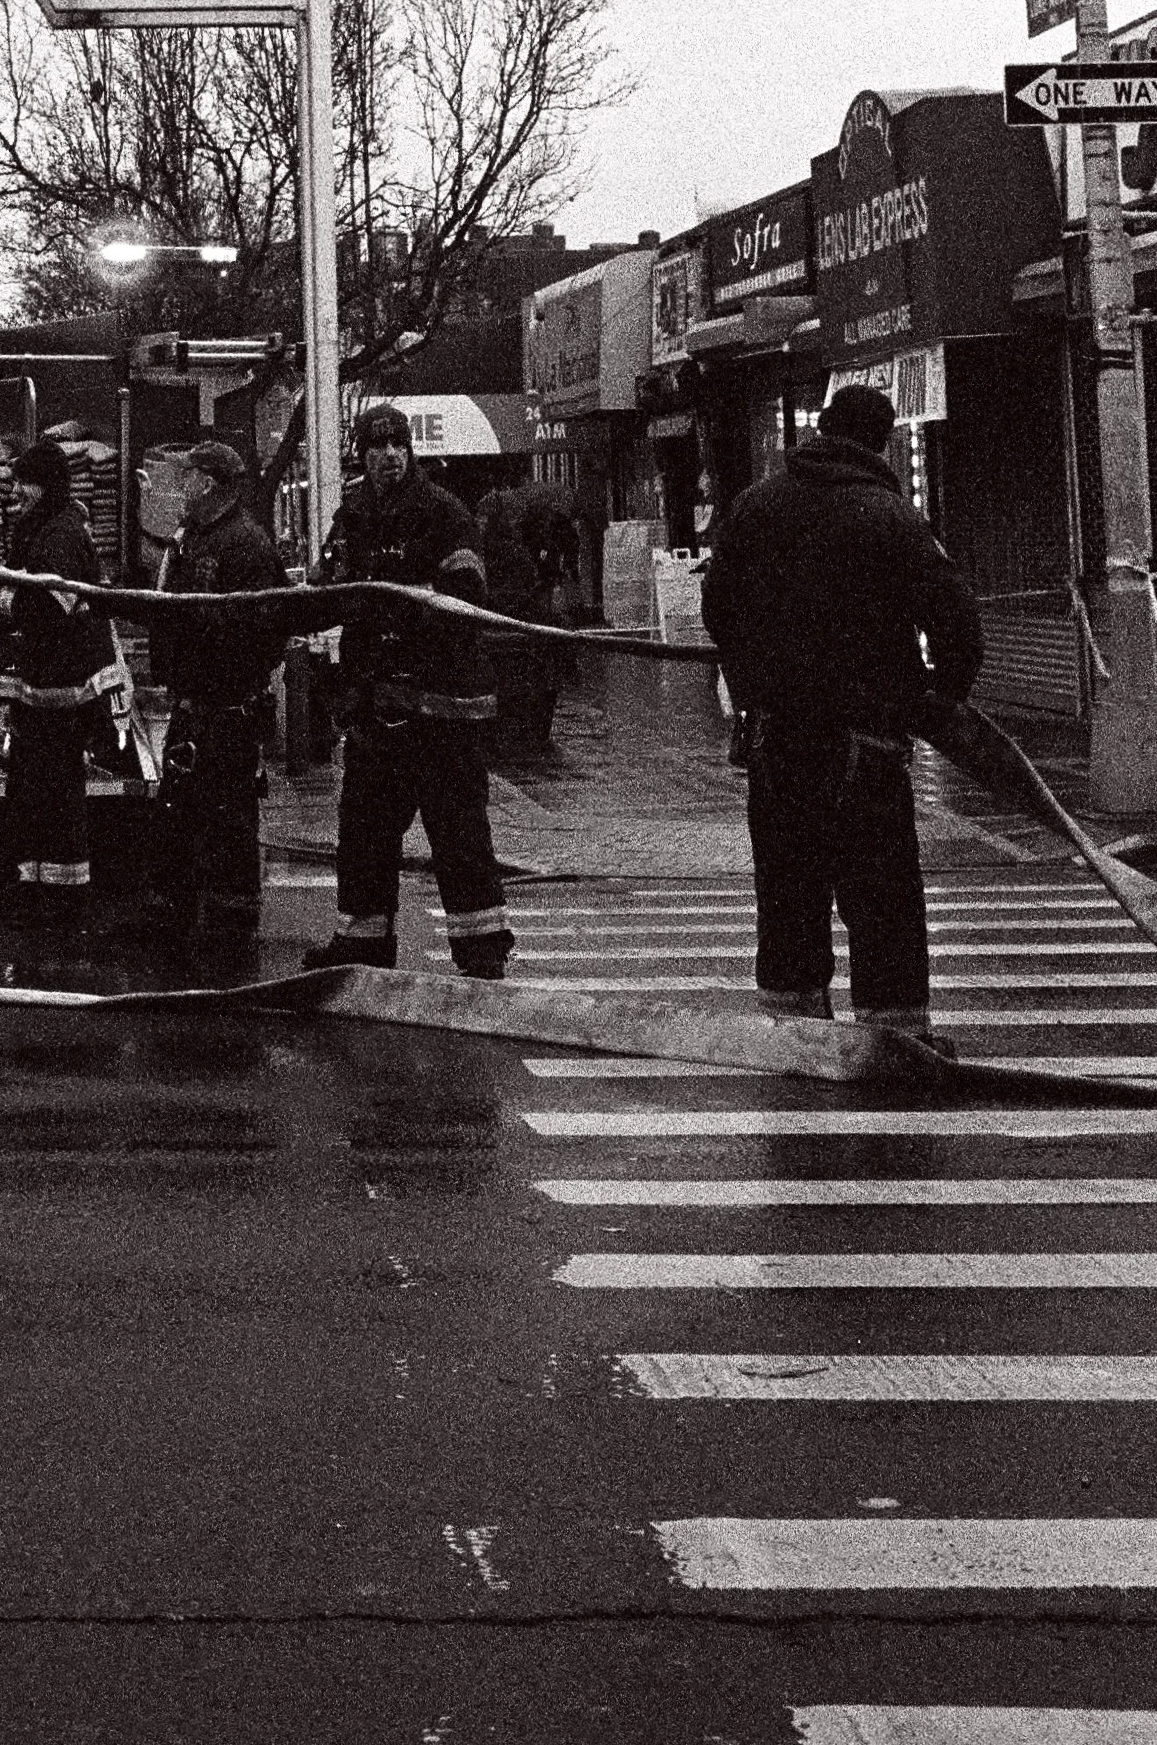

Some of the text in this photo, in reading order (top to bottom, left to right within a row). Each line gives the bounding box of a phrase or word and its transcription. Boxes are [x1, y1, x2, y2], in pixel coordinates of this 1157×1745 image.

[1035, 81, 1086, 106] ONE
[839, 99, 892, 180] OPTICAL
[731, 213, 781, 269] Sofra
[818, 175, 928, 270] LENS LAB EXPRESS
[535, 422, 566, 440] ATM
